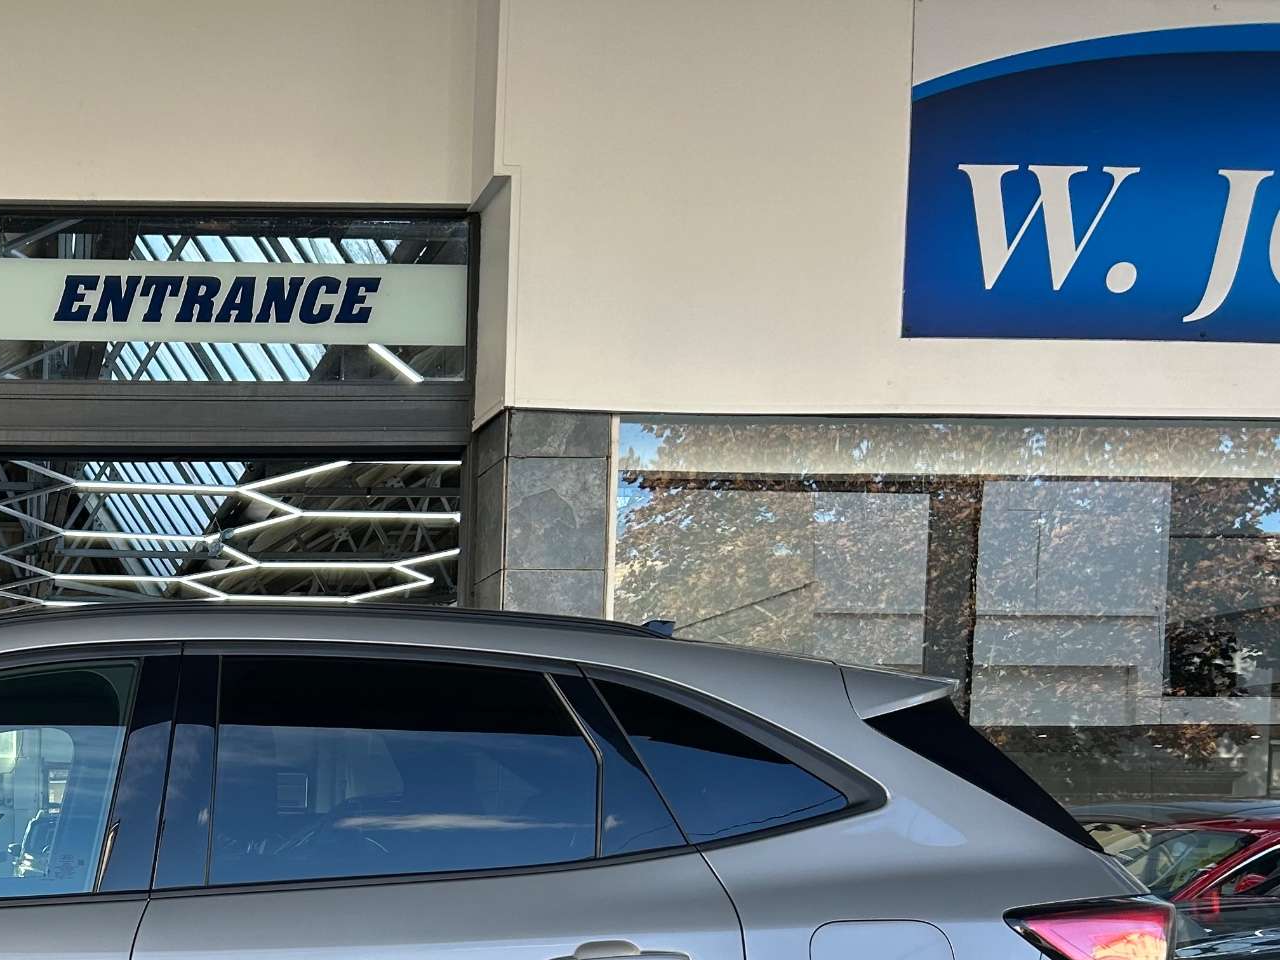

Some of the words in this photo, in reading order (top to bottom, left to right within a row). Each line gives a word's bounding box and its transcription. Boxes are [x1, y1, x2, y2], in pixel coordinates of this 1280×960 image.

[958, 163, 1141, 294] W.
[1183, 168, 1280, 323] J
[53, 274, 382, 325] ENTRANCE
